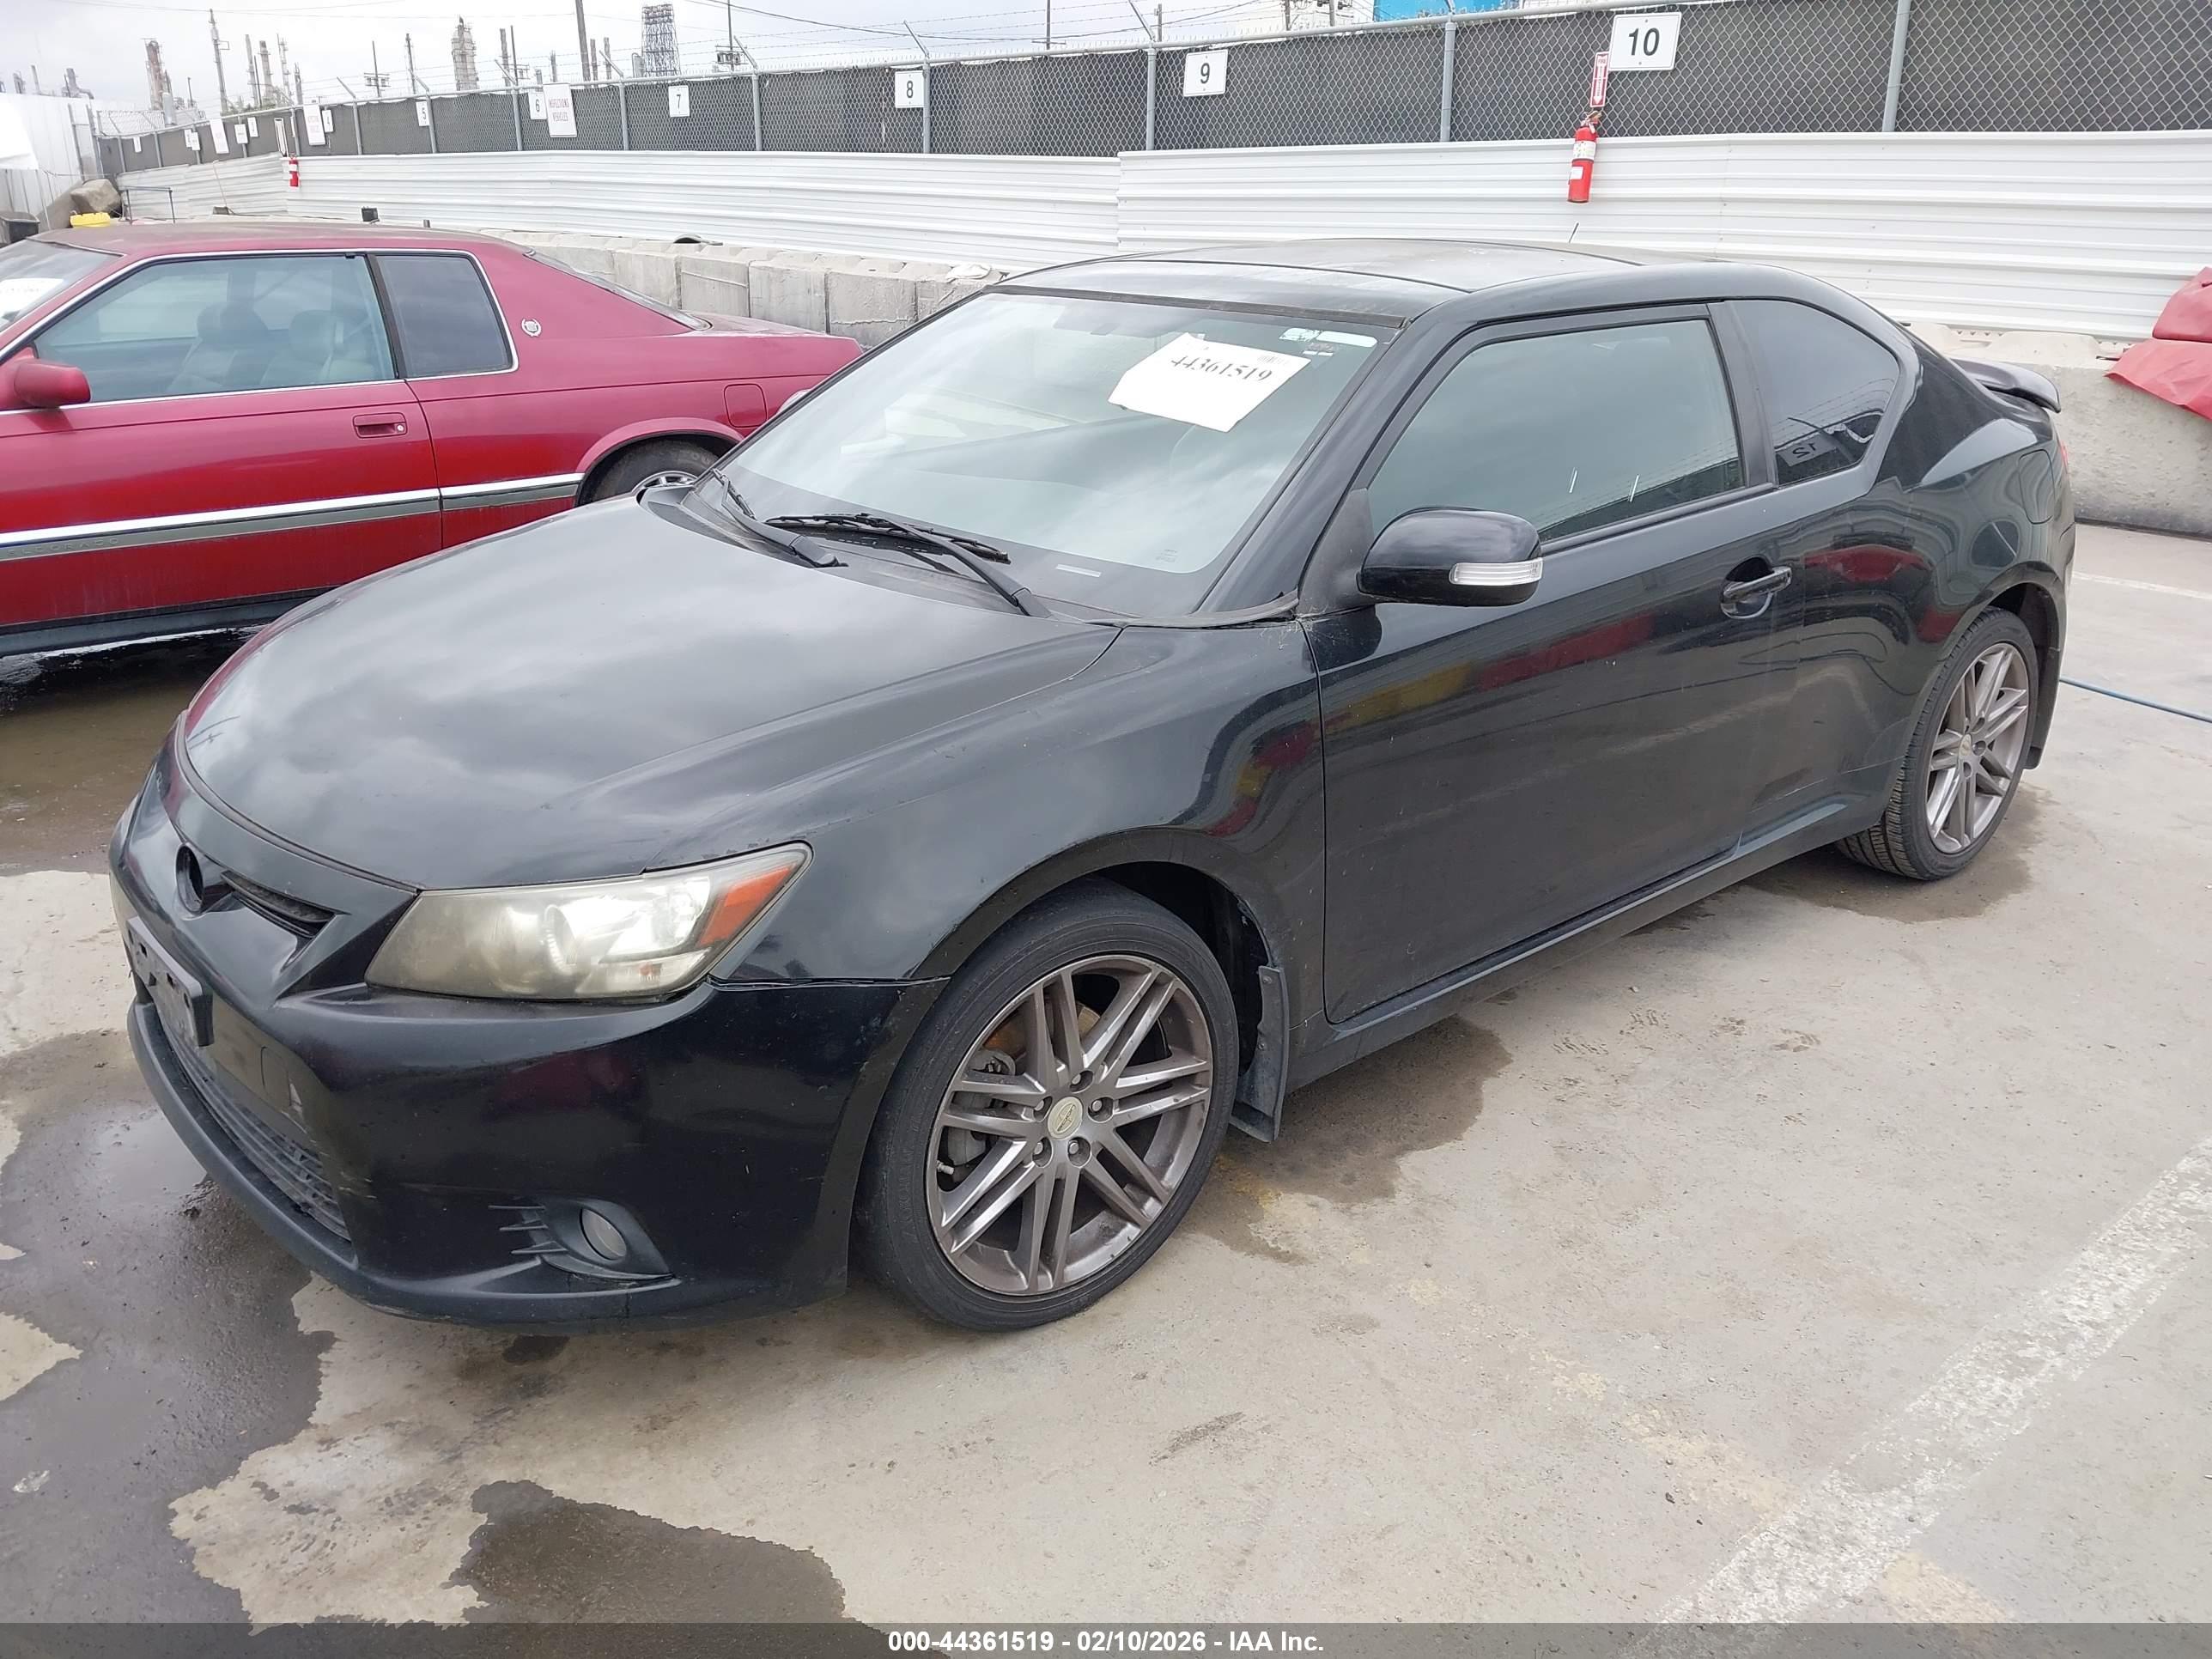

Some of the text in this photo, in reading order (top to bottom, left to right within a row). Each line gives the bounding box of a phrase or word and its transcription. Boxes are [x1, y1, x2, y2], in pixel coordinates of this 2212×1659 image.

[1628, 27, 1660, 57] 10
[1200, 62, 1211, 84] 9
[906, 80, 914, 99] 8
[535, 98, 540, 112] 6
[676, 94, 681, 109] 7
[1170, 355, 1273, 381] 44361519
